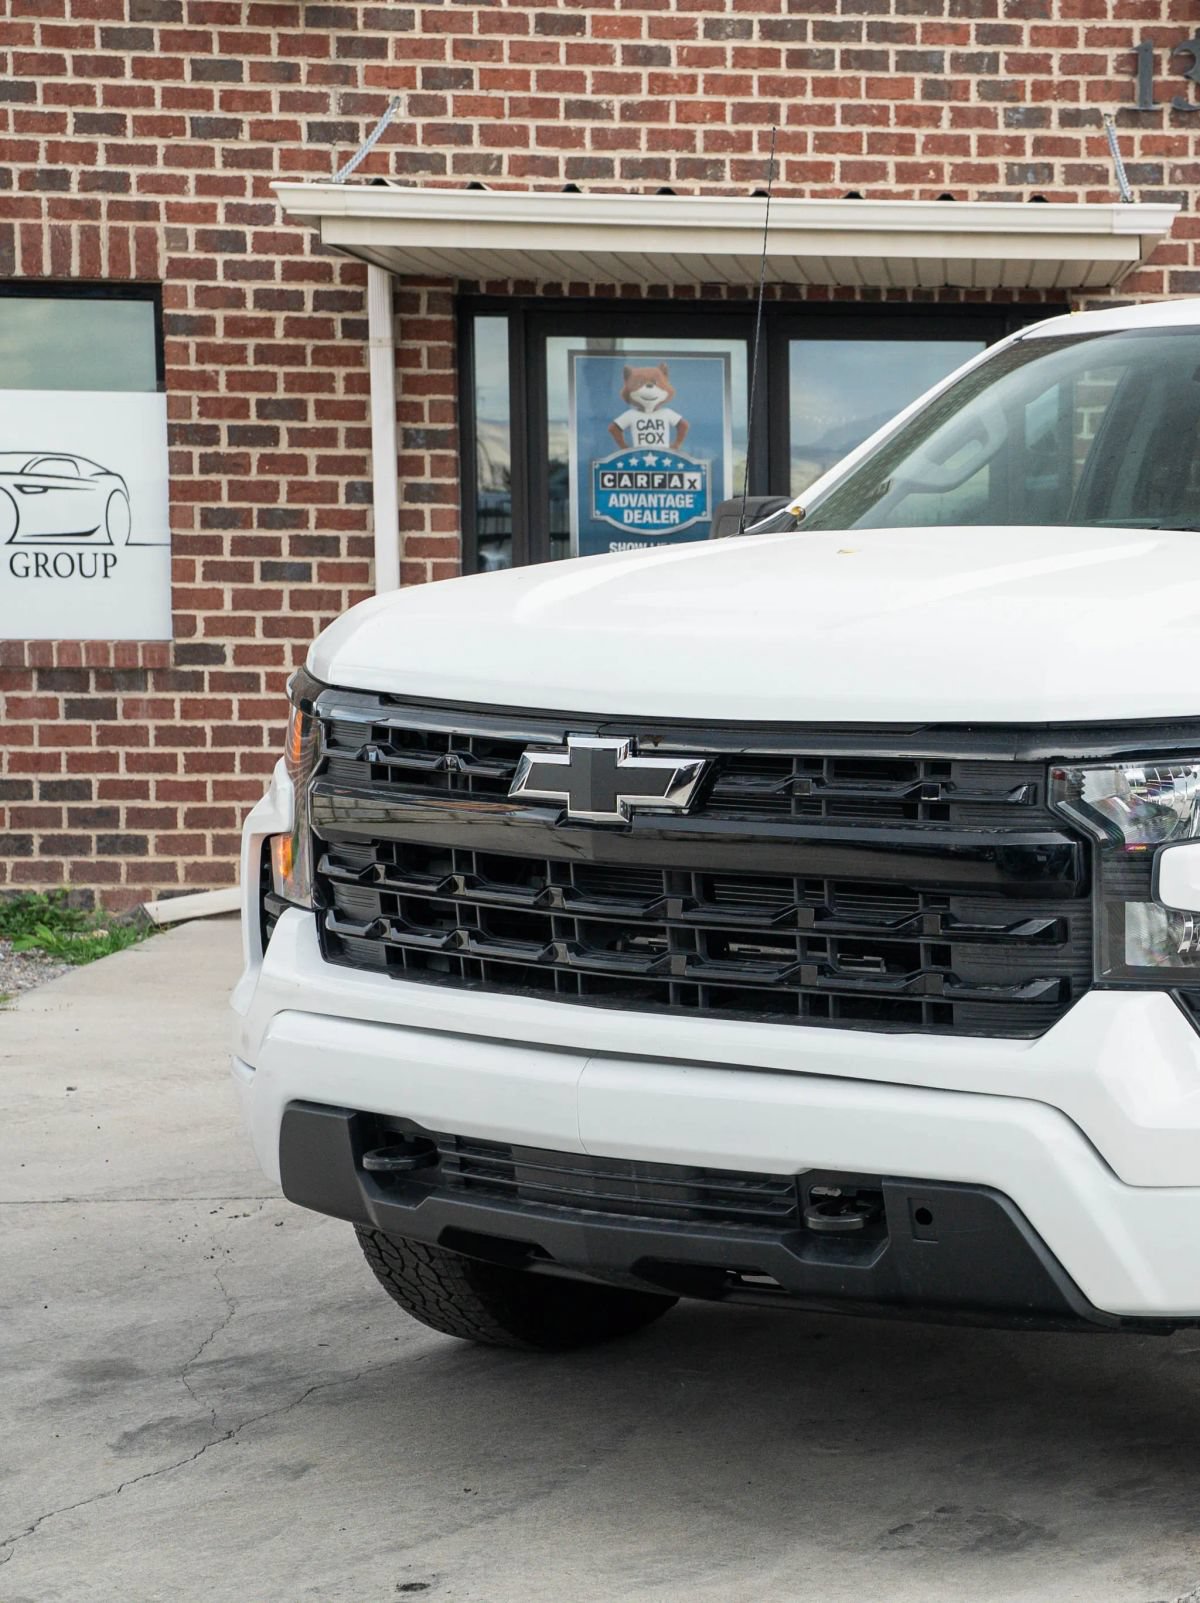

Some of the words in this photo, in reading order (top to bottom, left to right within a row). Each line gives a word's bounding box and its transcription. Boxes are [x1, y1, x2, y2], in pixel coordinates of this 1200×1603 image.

[636, 419, 665, 431] CAR
[637, 432, 665, 444] FOX
[602, 473, 700, 490] CARFAX
[608, 493, 694, 508] ADVANTAGE
[623, 510, 680, 524] DEALER
[9, 551, 118, 579] GROUP
